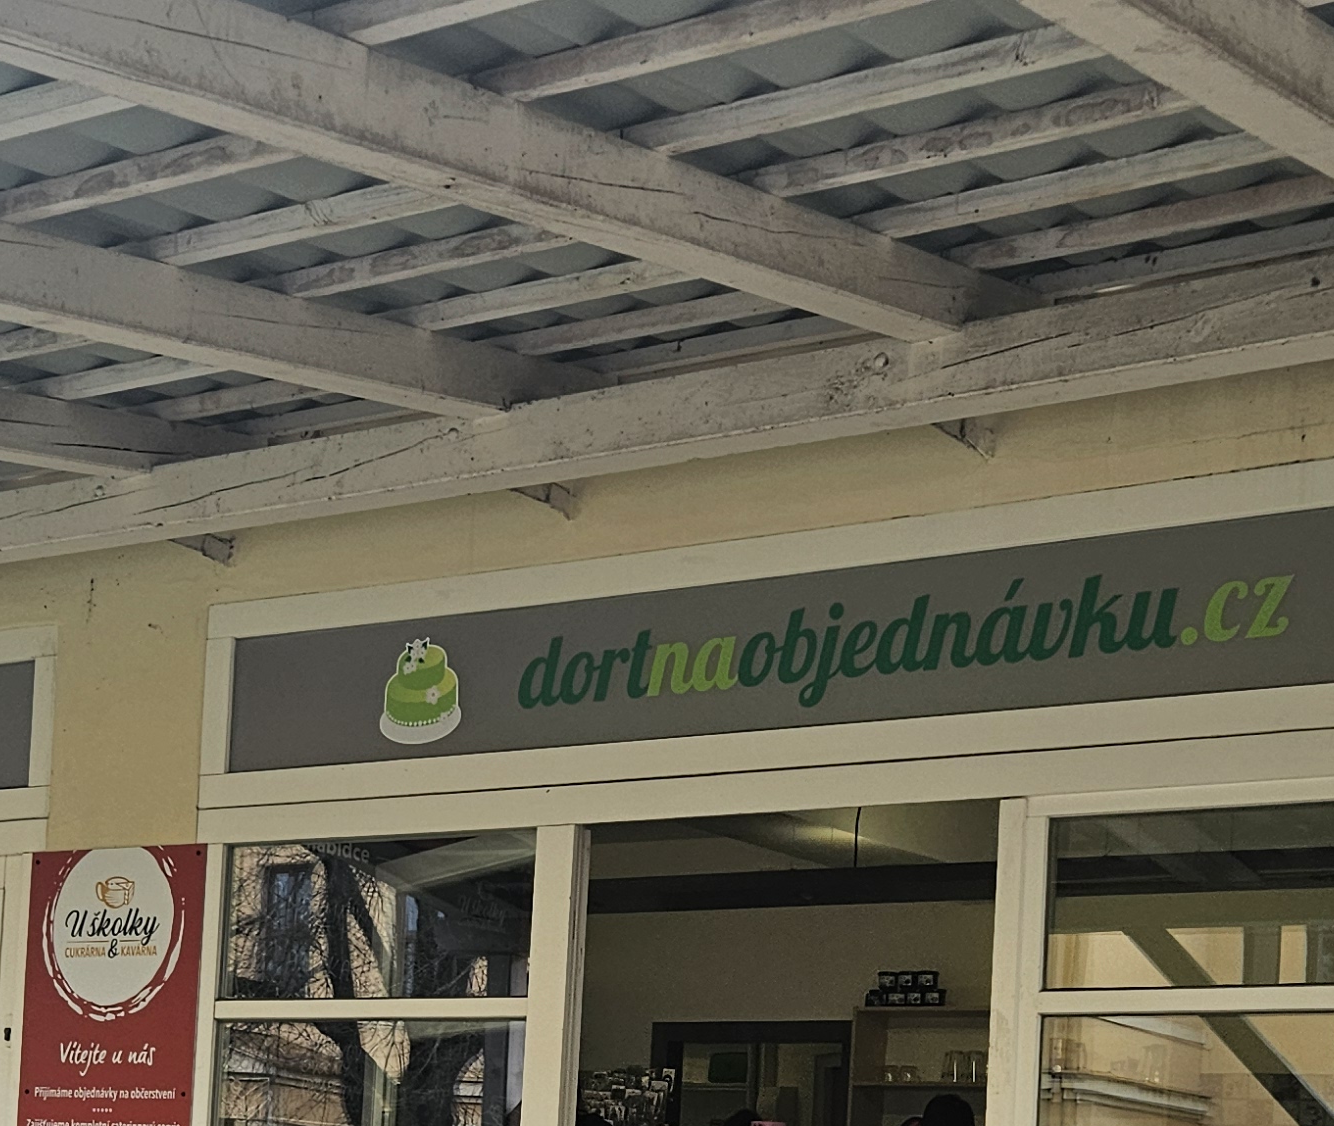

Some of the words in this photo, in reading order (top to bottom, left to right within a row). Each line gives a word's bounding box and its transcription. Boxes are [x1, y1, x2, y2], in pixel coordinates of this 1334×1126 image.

[517, 573, 1296, 709] dortnaobjednávku.cz
[65, 910, 88, 938] U
[87, 907, 160, 946] školky
[65, 945, 106, 958] CUKRÁRNA
[107, 938, 119, 959] &
[120, 944, 157, 957] KAVÁRNA
[60, 1041, 107, 1077] Vítejte
[111, 1049, 122, 1064] u
[127, 1043, 156, 1066] nás
[34, 1086, 73, 1101] Přijímáme
[73, 1087, 118, 1102] objednávky
[119, 1090, 129, 1099] na
[130, 1087, 176, 1099] občerstvení
